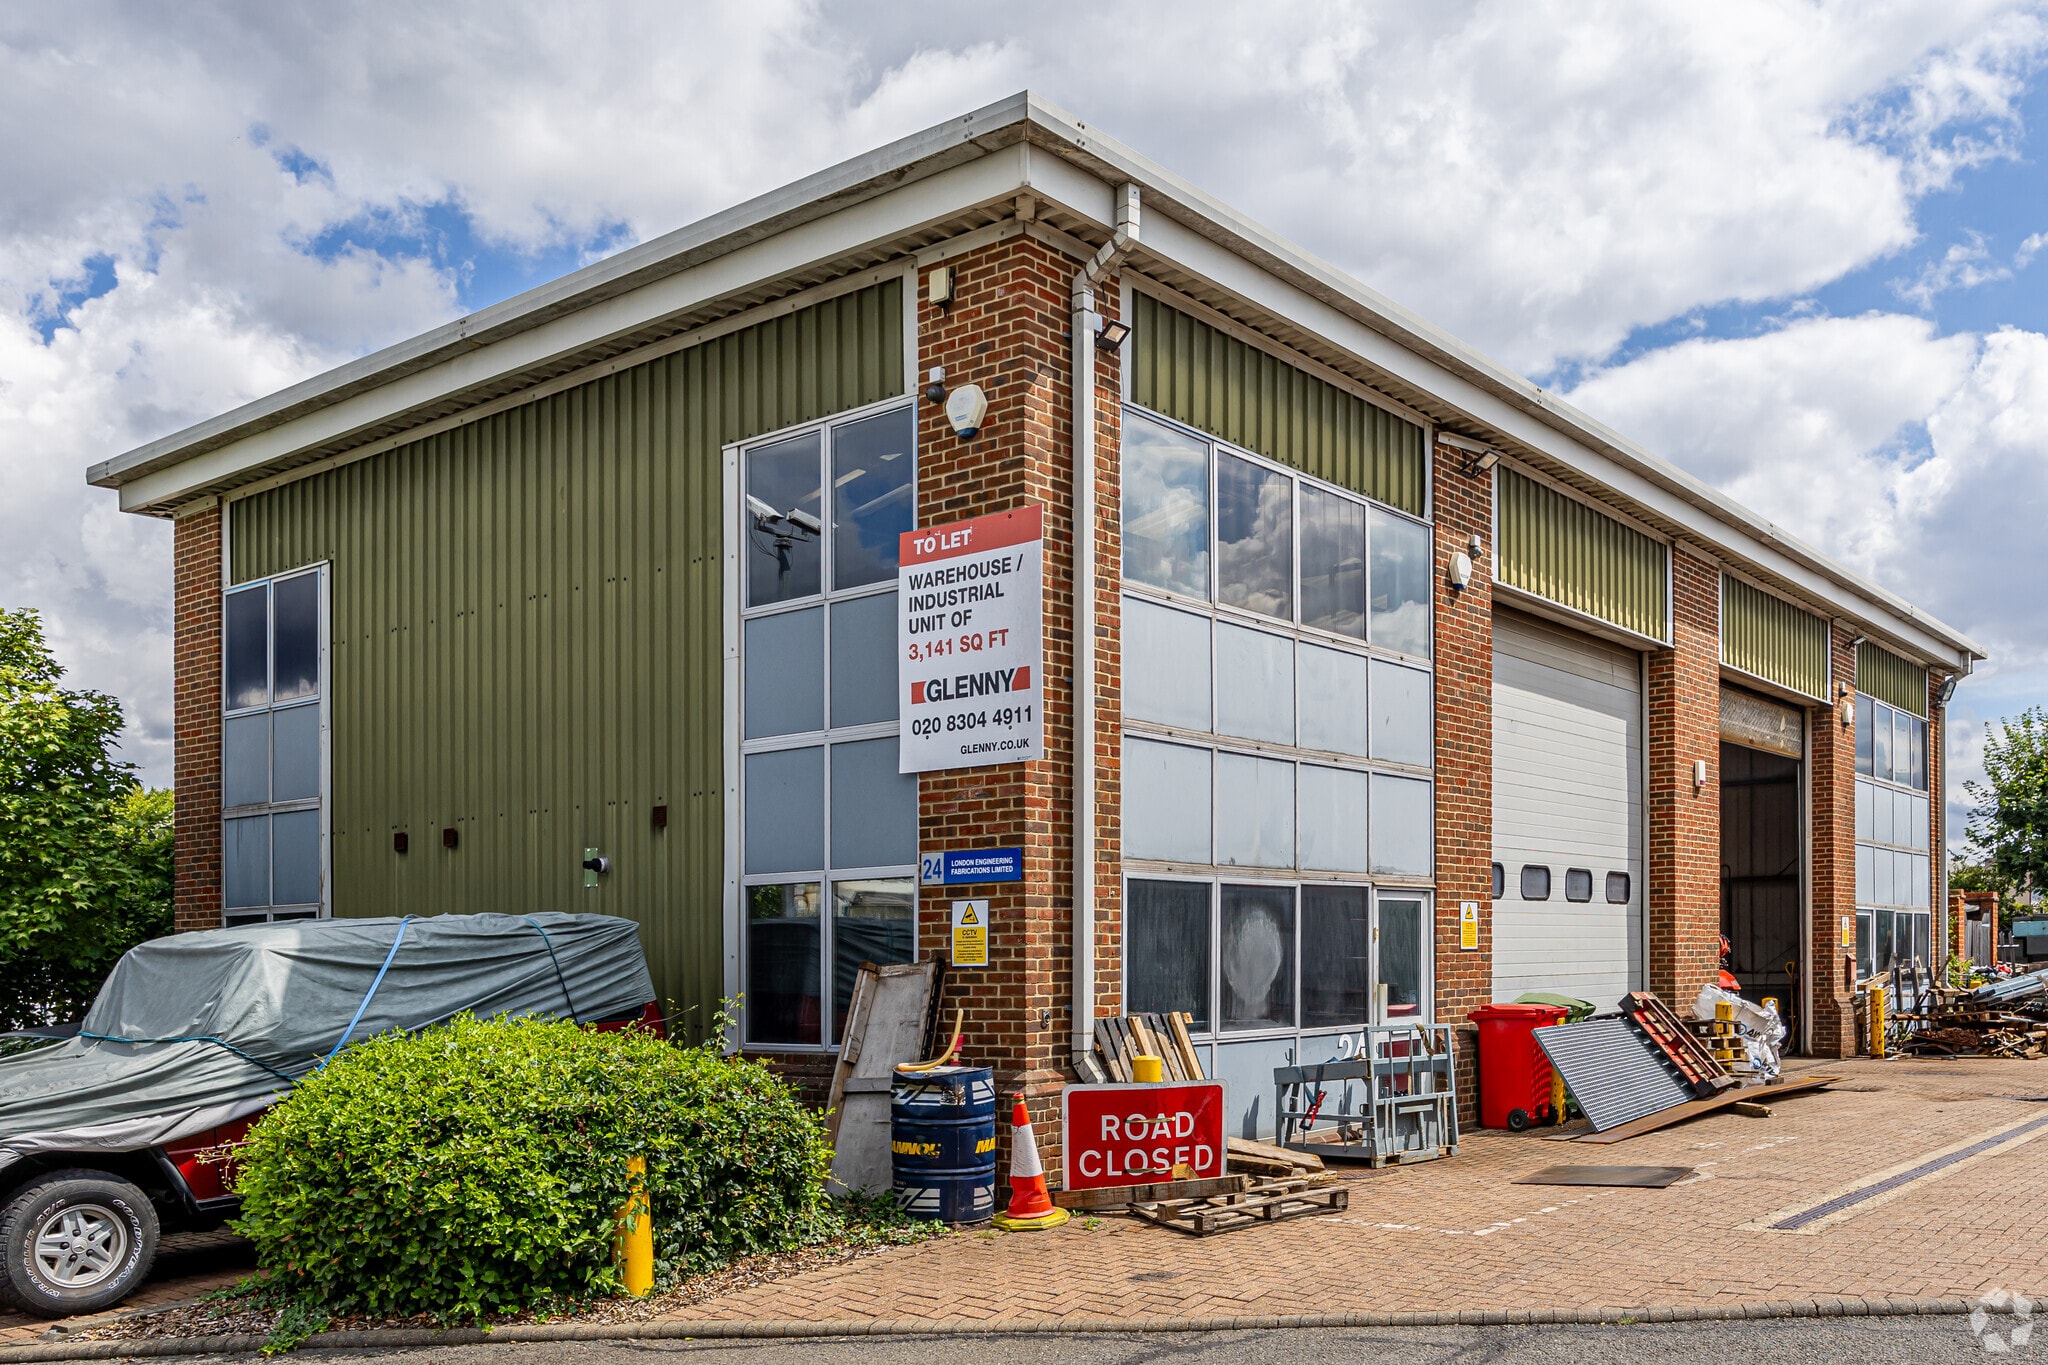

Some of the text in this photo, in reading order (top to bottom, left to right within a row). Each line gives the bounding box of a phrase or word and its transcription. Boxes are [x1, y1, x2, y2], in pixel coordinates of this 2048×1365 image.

[914, 528, 972, 555] TO LET
[908, 553, 1024, 591] WAREHOUSE /
[908, 581, 1004, 613] INDUSTRIAL
[908, 609, 973, 635] UNIT OF
[908, 628, 1009, 662] 3,141 SQ FT
[926, 668, 1015, 703] GLENNY
[912, 705, 1032, 736] 020 8304 4911
[960, 738, 1030, 755] GLENNY.CO.UK
[923, 858, 942, 880] 24
[950, 865, 1014, 875] FABRICATIONS LIMITED
[951, 857, 1013, 867] LONDON ENGINEERING
[1101, 1111, 1195, 1141] ROAD
[1078, 1144, 1214, 1178] CLOSED
[108, 1199, 143, 1290] GOODYEAR
[23, 1229, 61, 1298] WRANGLER
